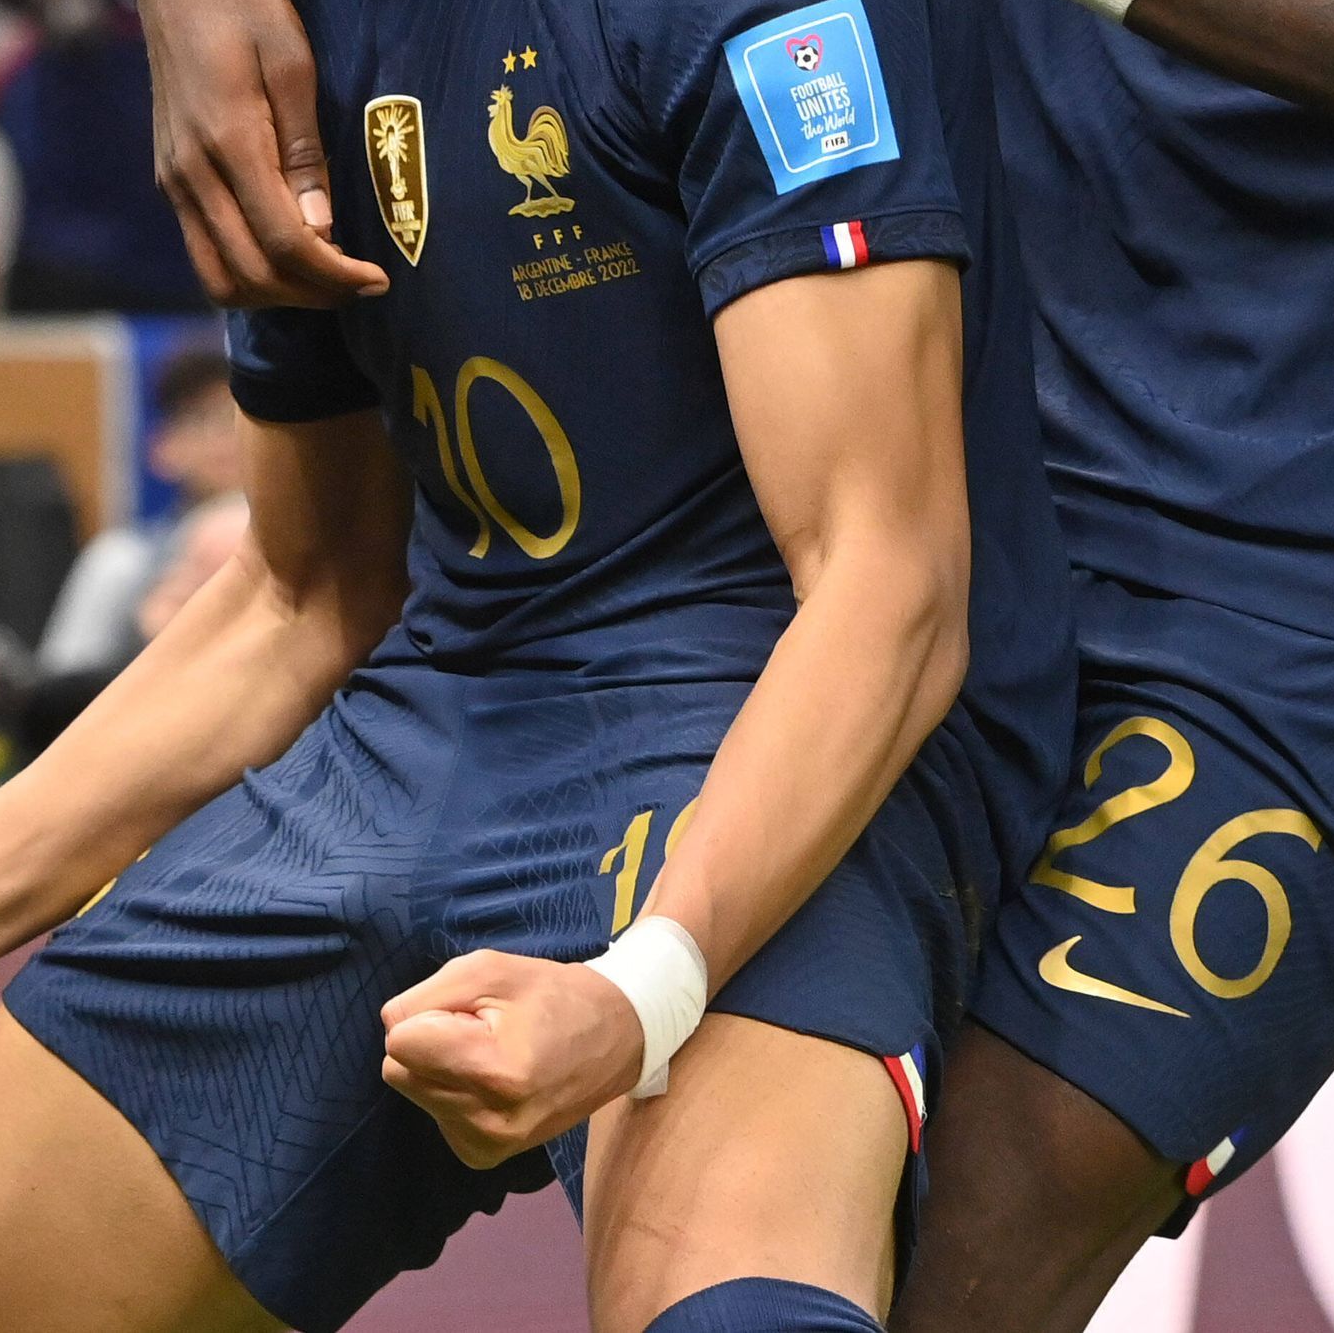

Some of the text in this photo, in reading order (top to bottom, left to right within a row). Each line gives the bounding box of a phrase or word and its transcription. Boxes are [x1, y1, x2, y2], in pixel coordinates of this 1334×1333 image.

[790, 72, 846, 102] FOOTBALL
[796, 87, 851, 121] UNITES
[801, 107, 855, 140] the World
[825, 136, 846, 149] FIFA
[511, 254, 573, 282] ARGENTINE
[584, 242, 634, 265] FRANCE
[517, 283, 533, 301] 18
[597, 258, 641, 282] 2022
[410, 356, 581, 560] 10
[599, 795, 703, 937] 1
[1028, 716, 1323, 999] 26
